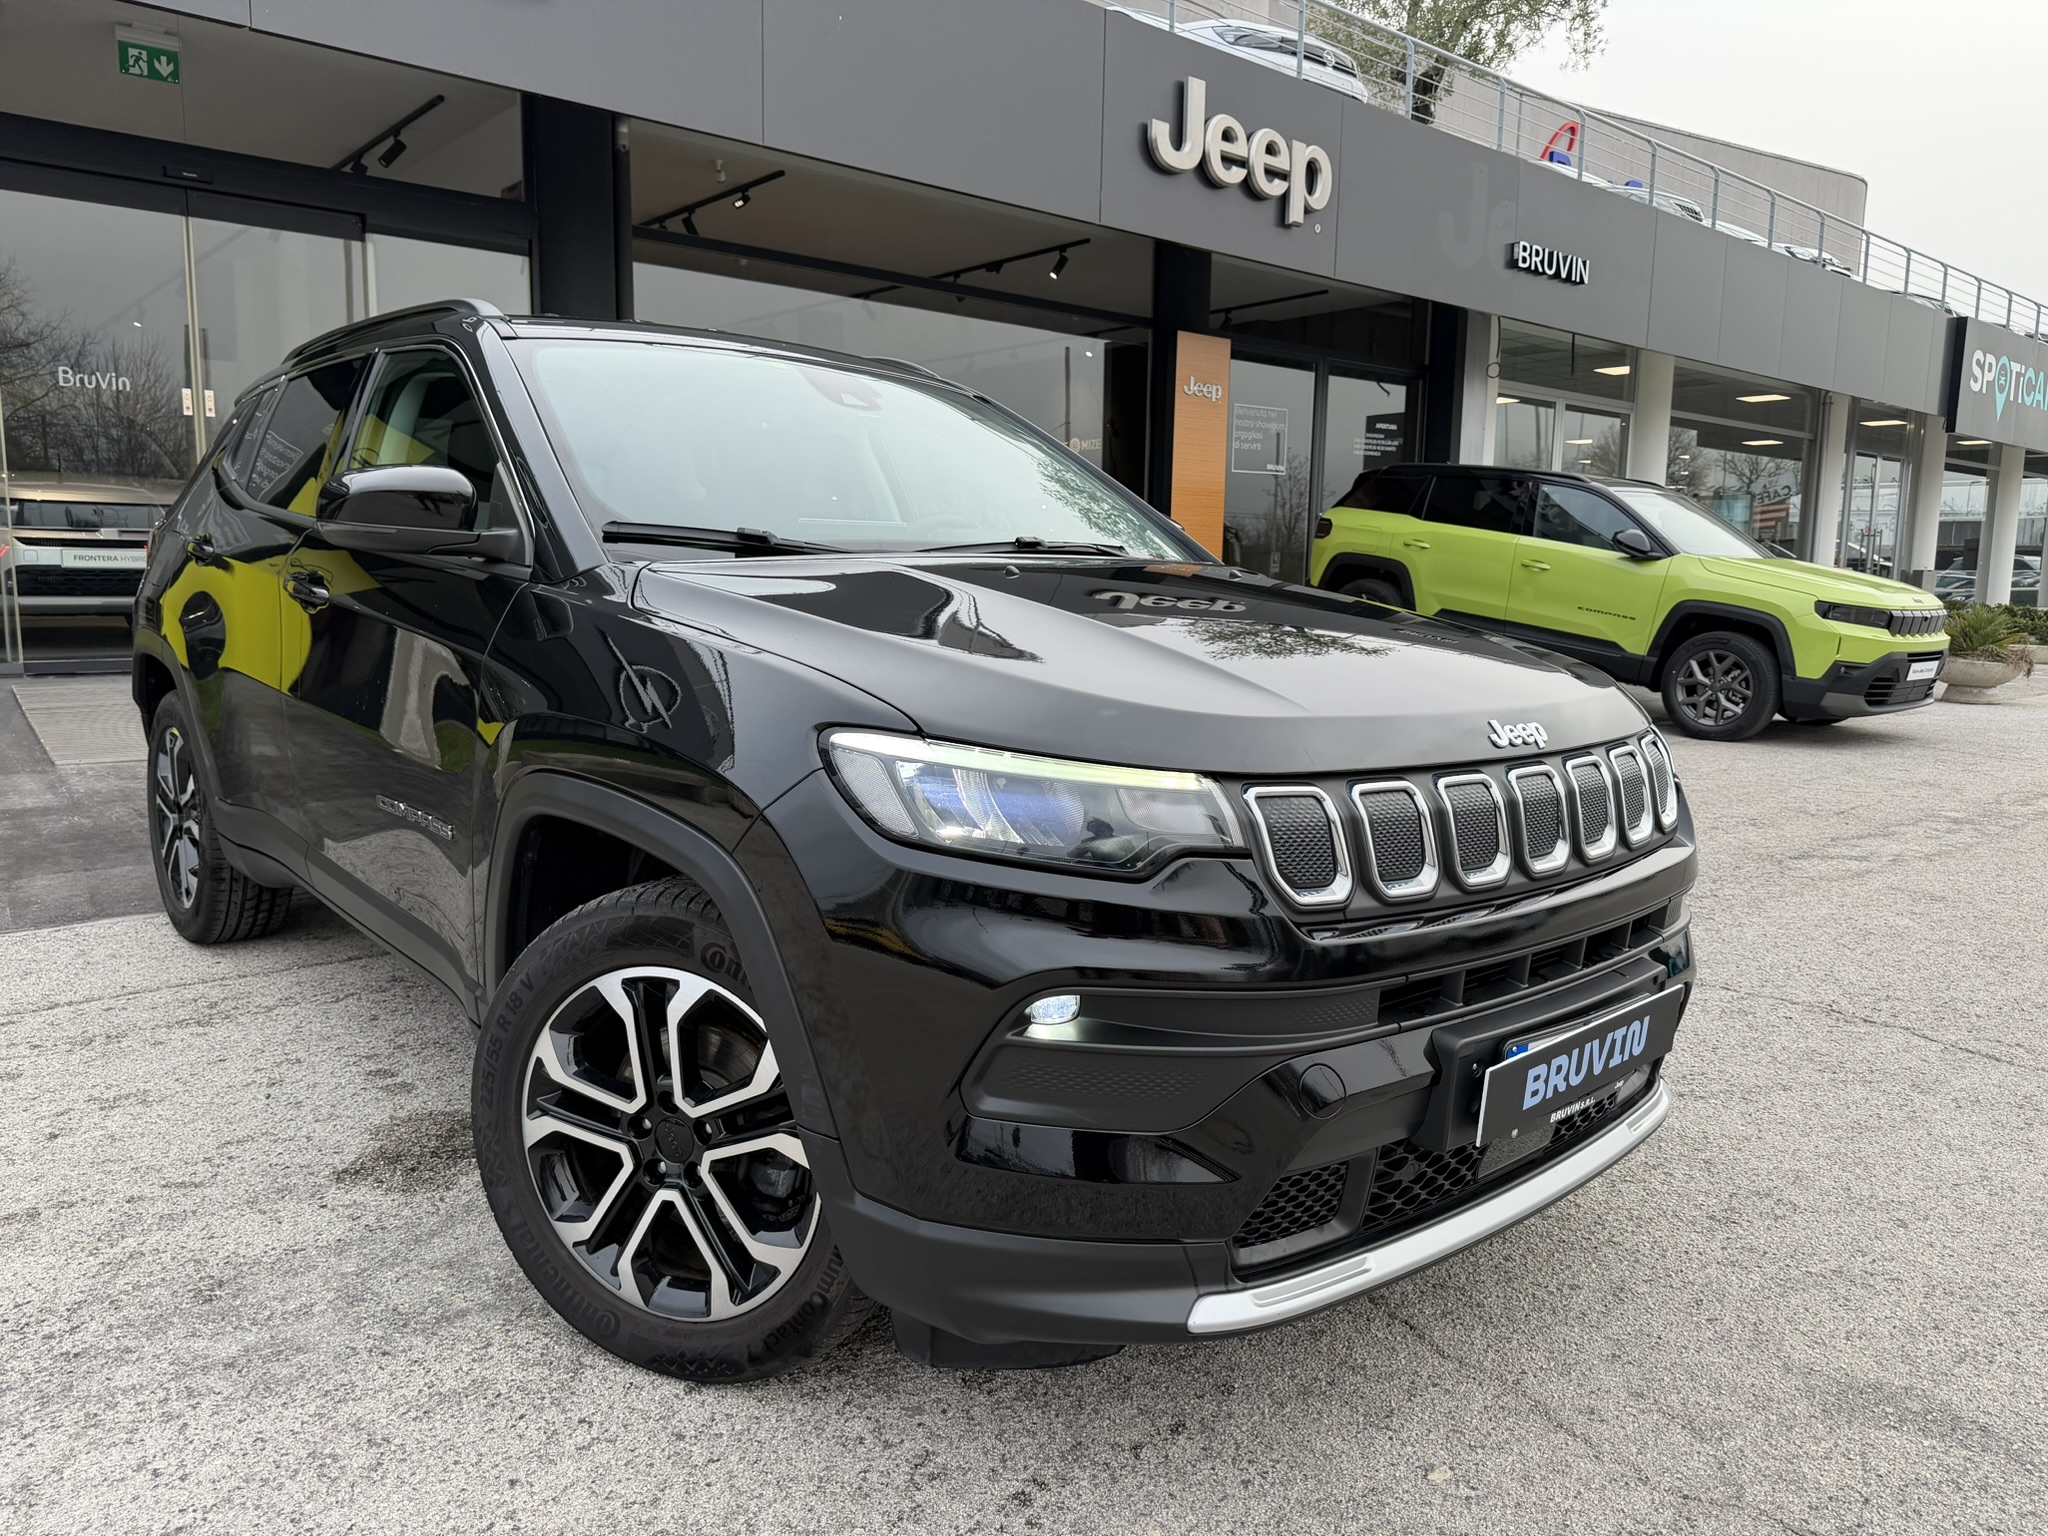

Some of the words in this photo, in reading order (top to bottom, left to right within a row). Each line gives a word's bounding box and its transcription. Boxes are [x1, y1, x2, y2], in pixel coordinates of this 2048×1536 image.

[1148, 76, 1332, 227] Jeep
[1516, 240, 1590, 284] BRUVIN
[58, 366, 131, 391] BruVin
[1183, 376, 1222, 403] Jeep
[74, 554, 119, 563] FRONTERA
[1577, 606, 1636, 621] COMPASS
[1487, 719, 1548, 750] Jeep
[376, 795, 455, 840] COMPASS
[480, 1035, 504, 1110] 225/55
[497, 1014, 513, 1035] R
[505, 990, 523, 1016] 18
[520, 972, 535, 993] V
[1522, 1015, 1650, 1110] BRUVIN
[1550, 1101, 1580, 1123] BRUVIN
